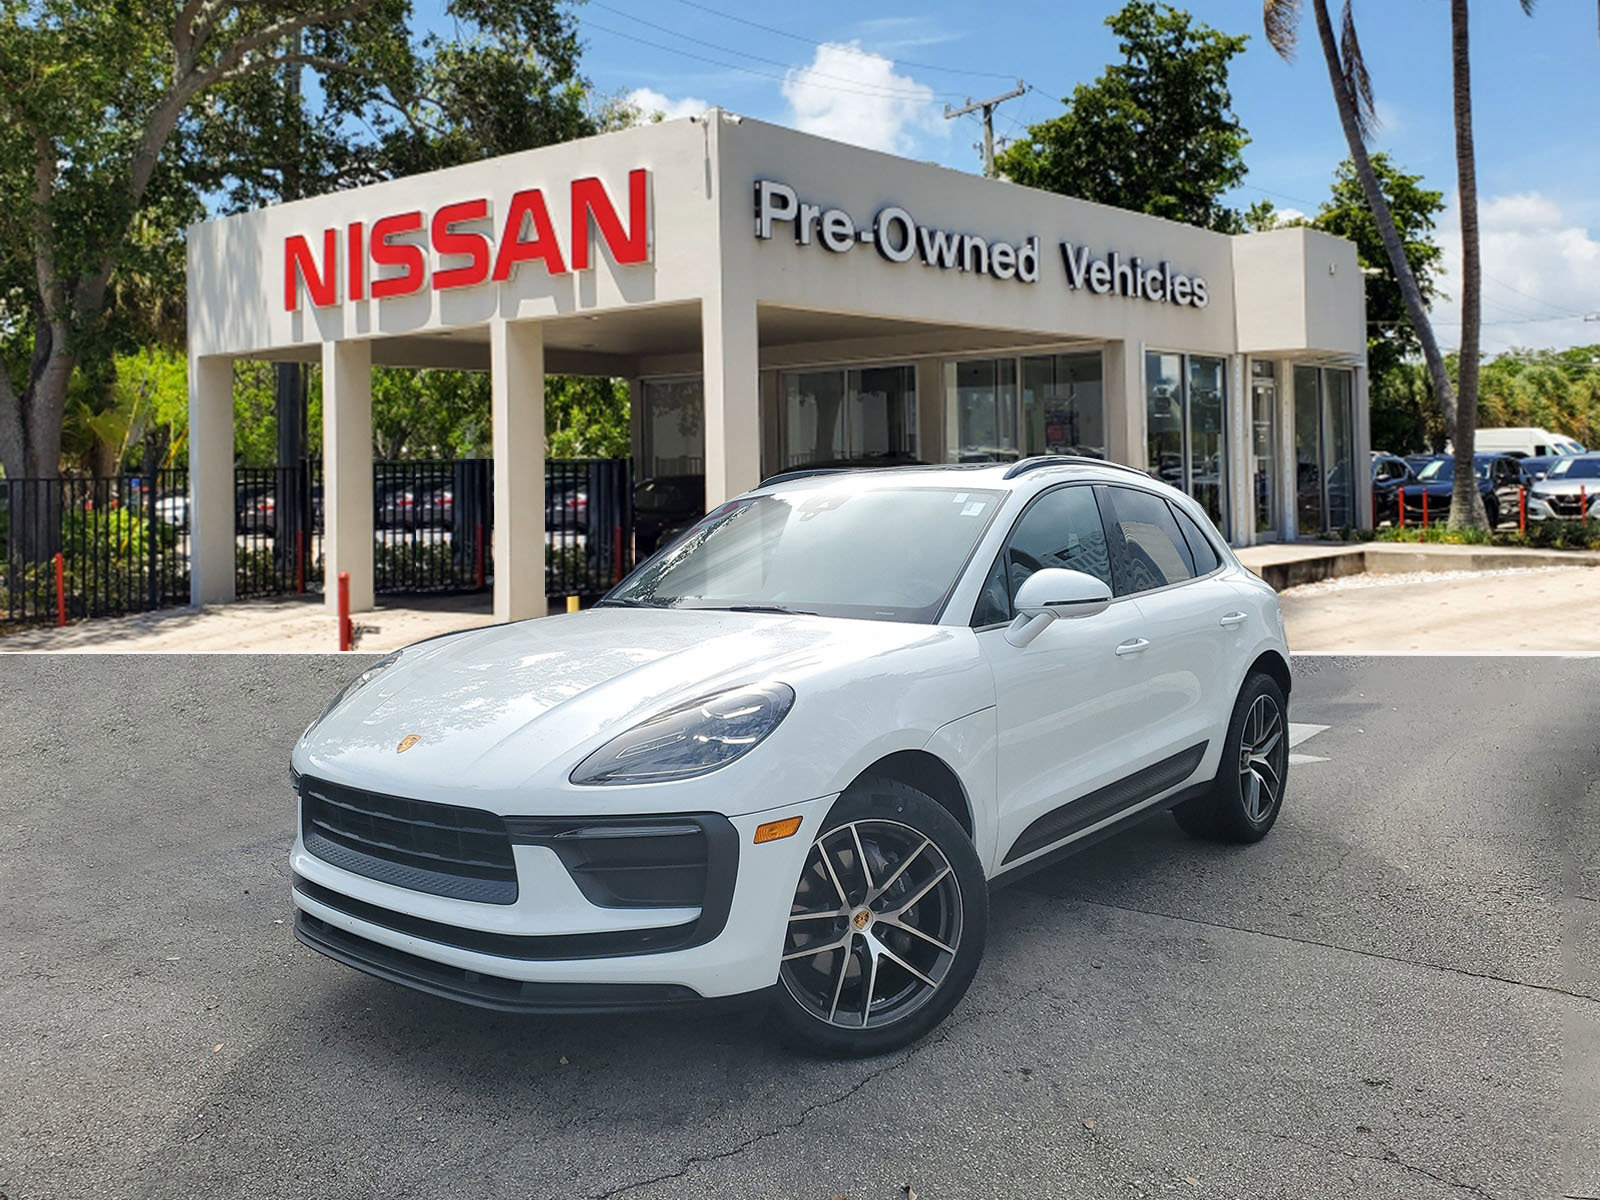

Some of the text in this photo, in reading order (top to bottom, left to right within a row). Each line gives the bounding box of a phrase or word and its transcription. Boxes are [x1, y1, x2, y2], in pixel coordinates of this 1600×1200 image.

[285, 168, 648, 311] NISSAN
[754, 179, 1208, 308] Pre-Owned Vehicles
